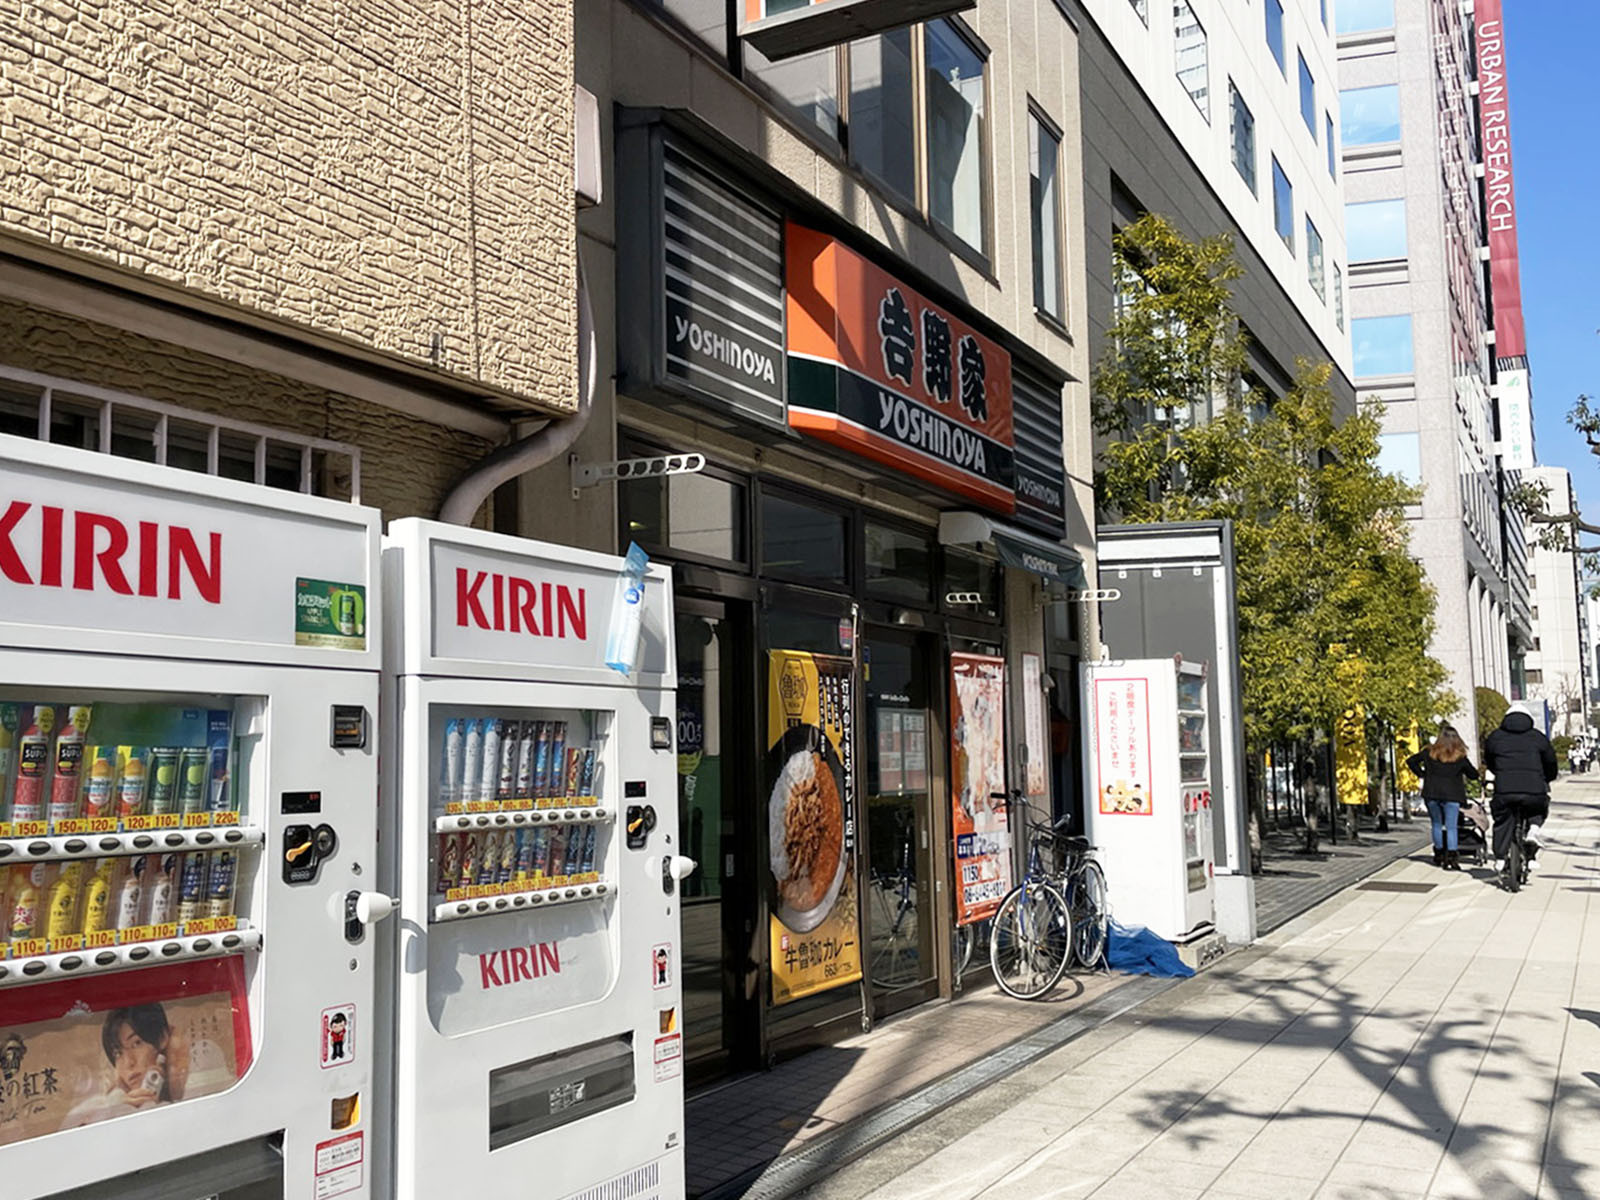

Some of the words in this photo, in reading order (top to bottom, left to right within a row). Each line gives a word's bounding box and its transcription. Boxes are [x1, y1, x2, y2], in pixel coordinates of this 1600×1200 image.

[1478, 21, 1504, 105] URBAN
[1484, 111, 1513, 232] RESEARCH
[0, 500, 222, 604] KIRIN
[456, 567, 586, 640] KIRIN
[479, 941, 560, 989] KIRIN
